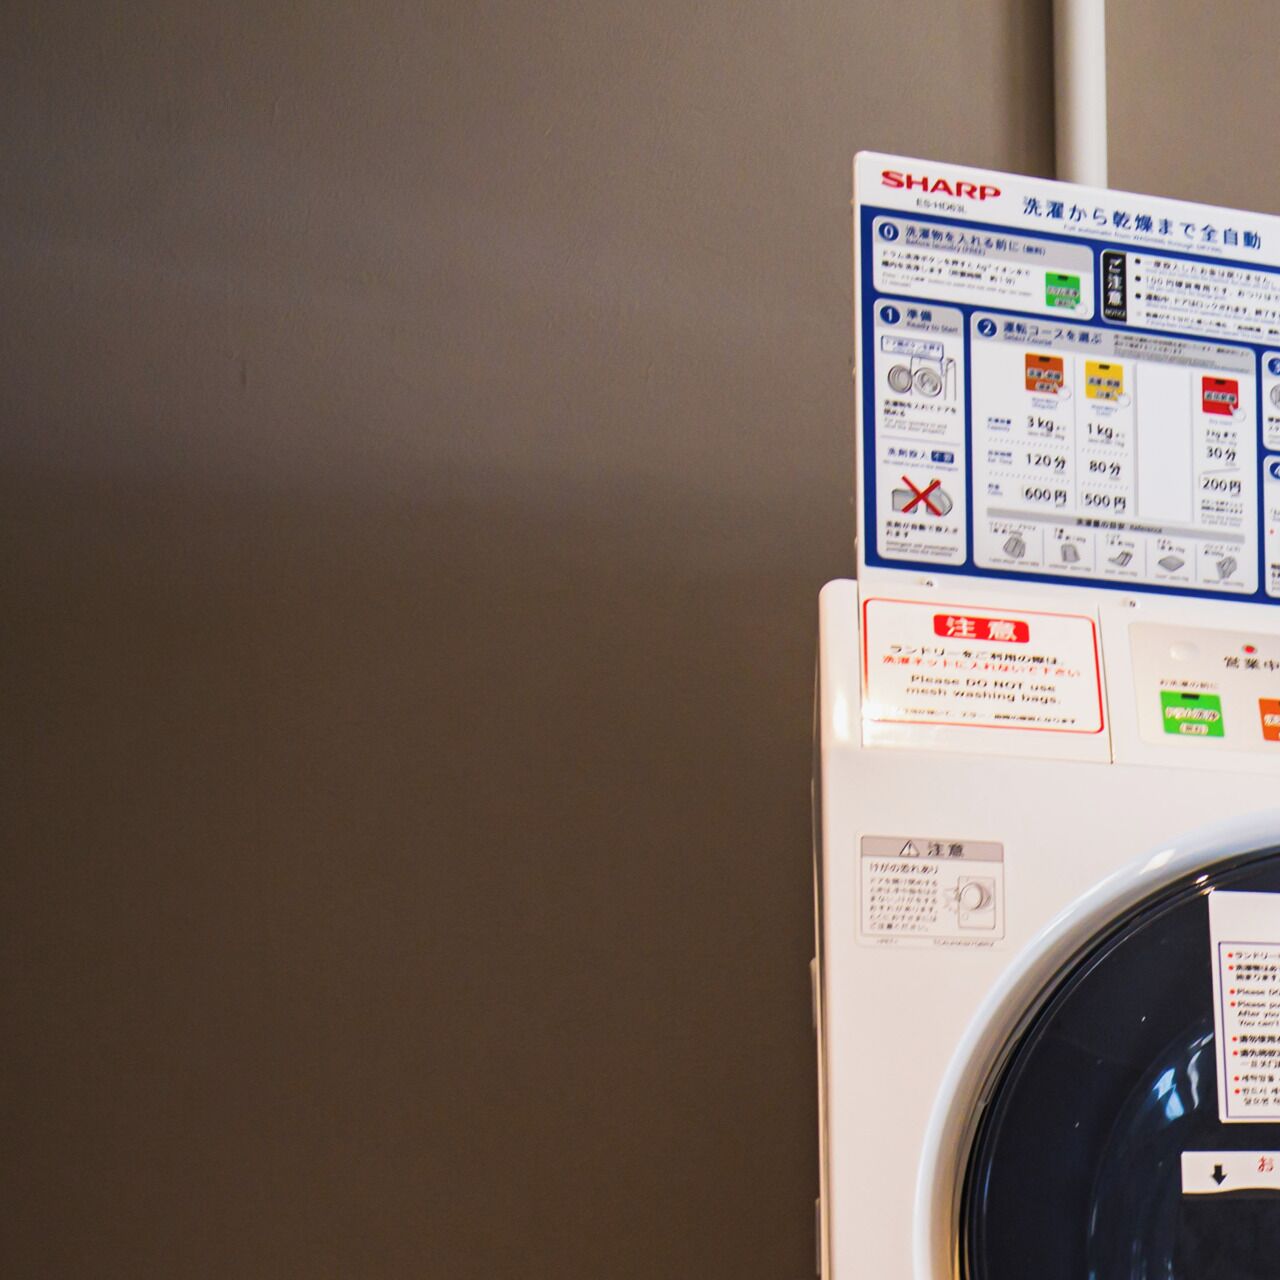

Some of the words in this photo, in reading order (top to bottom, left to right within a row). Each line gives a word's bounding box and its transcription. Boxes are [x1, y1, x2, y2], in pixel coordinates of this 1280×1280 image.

[881, 170, 1002, 201] SHARP
[1023, 195, 1262, 250] 洗濯から乾燥まで全自動
[946, 616, 1019, 641] 注意
[911, 674, 960, 686] Please
[954, 689, 1016, 703] washing
